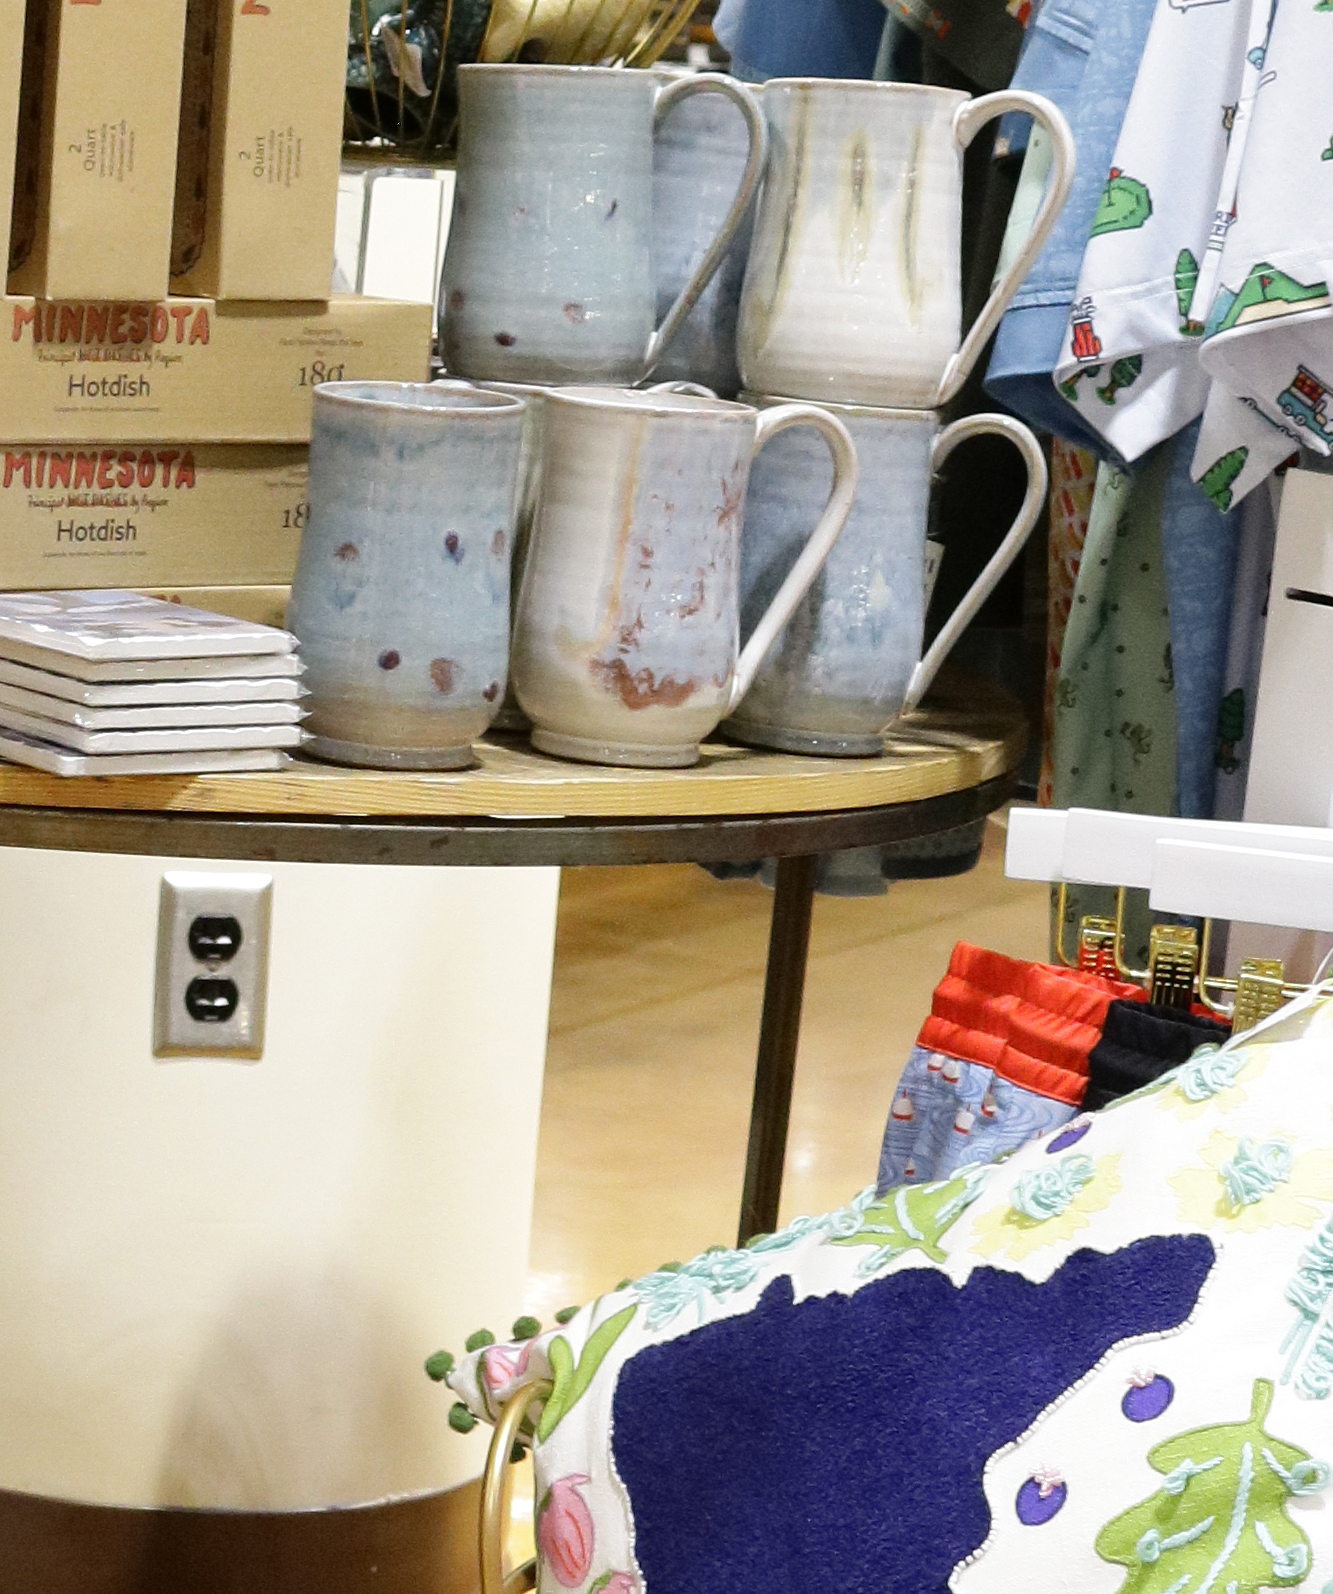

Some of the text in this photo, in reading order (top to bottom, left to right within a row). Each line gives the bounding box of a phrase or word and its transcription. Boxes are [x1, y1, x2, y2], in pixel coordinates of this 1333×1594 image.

[12, 304, 211, 345] MINNESOTA
[68, 374, 151, 397] Hotdish
[2, 449, 196, 489] MINNESOTA
[56, 518, 137, 542] Hotdish
